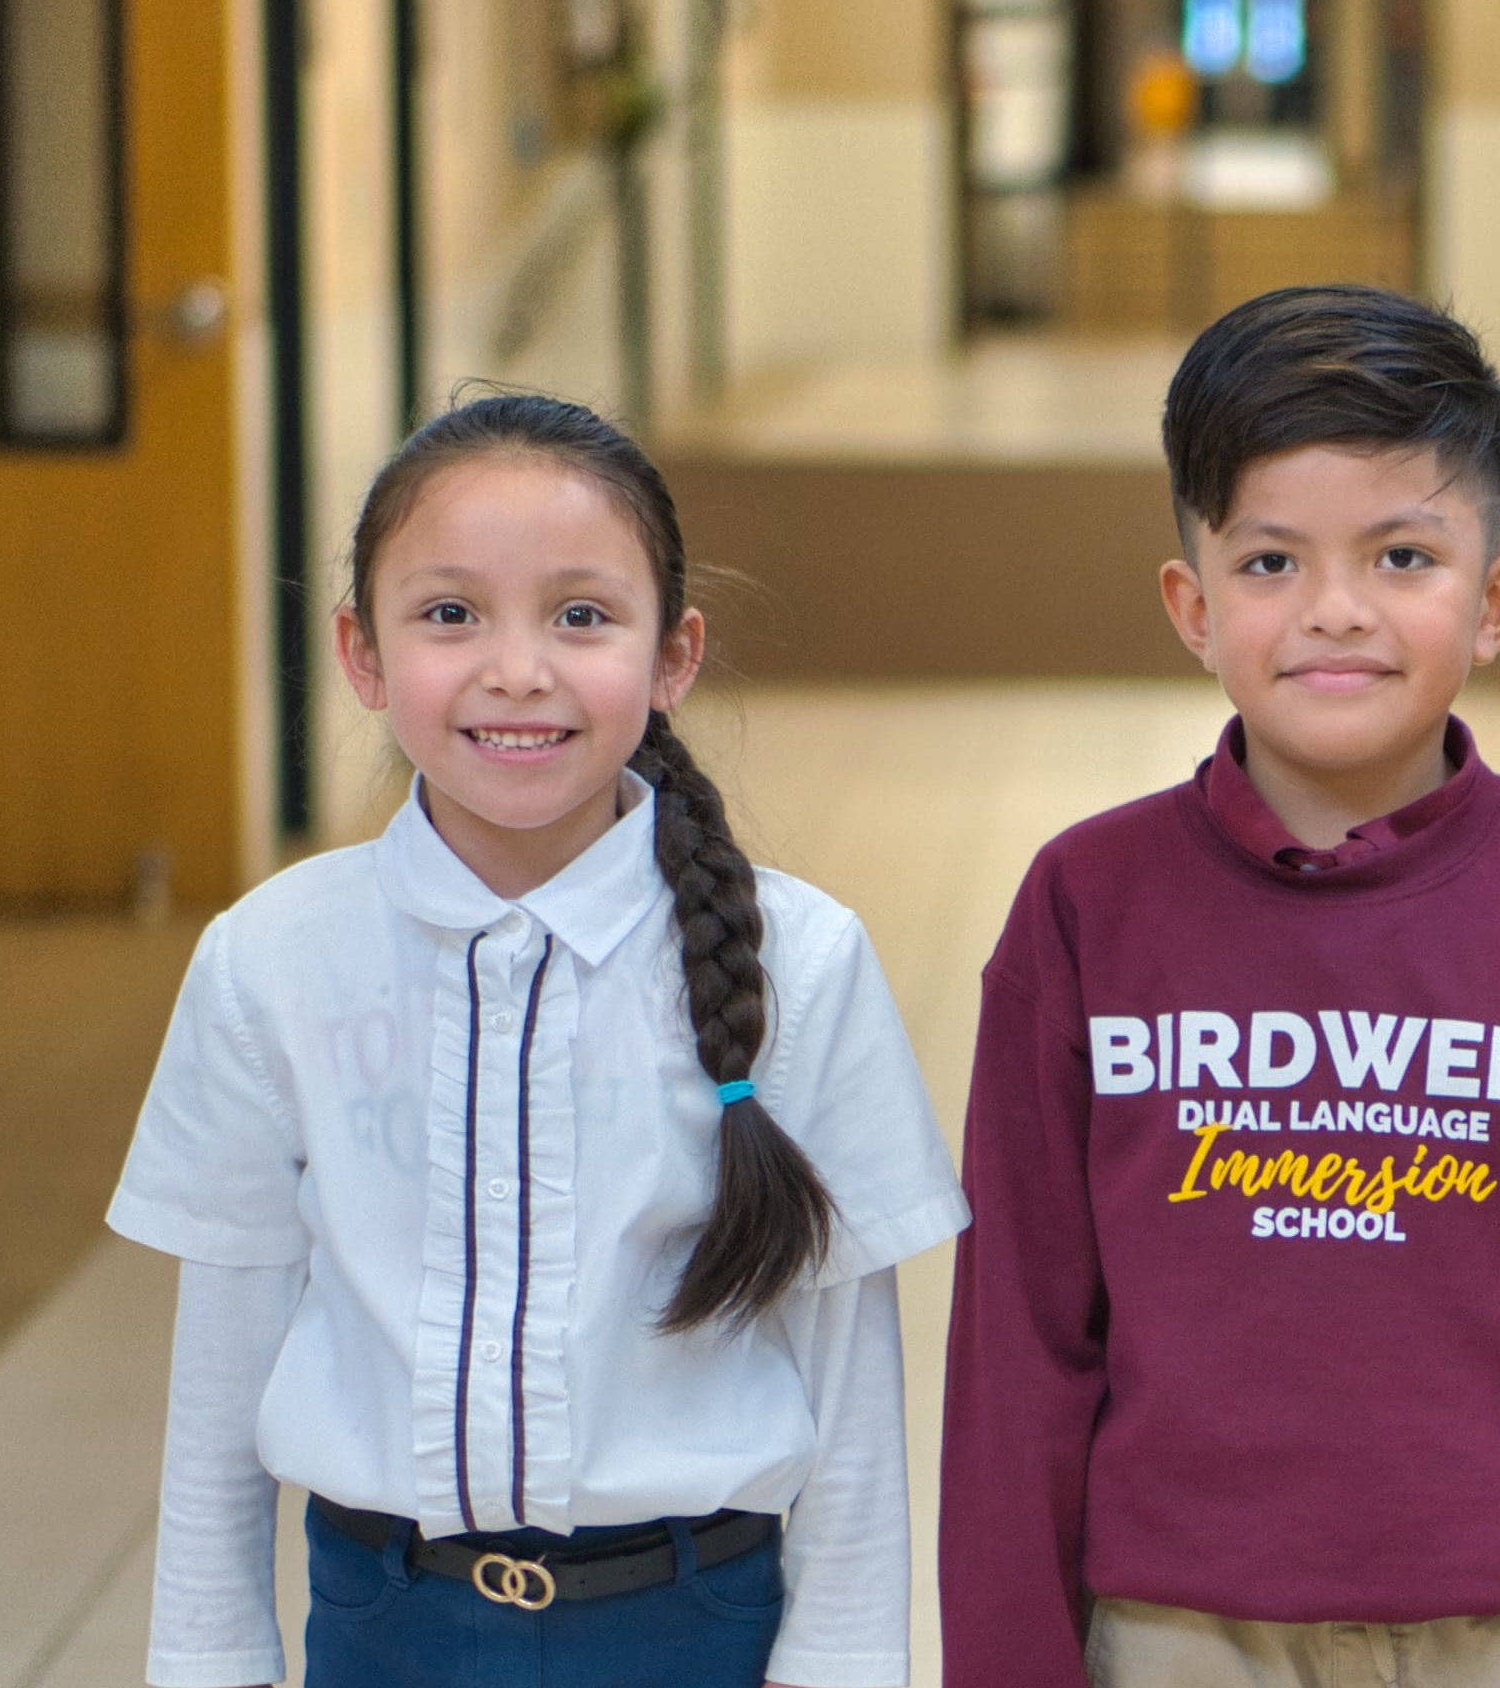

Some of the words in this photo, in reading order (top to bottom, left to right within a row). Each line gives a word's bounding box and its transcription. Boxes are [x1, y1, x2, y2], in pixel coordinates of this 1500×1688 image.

[1177, 1099, 1281, 1131] DUAL
[1288, 1100, 1490, 1143] LANGUAGE
[1167, 1122, 1498, 1216] Immersion
[1250, 1206, 1407, 1243] SCHOOL
